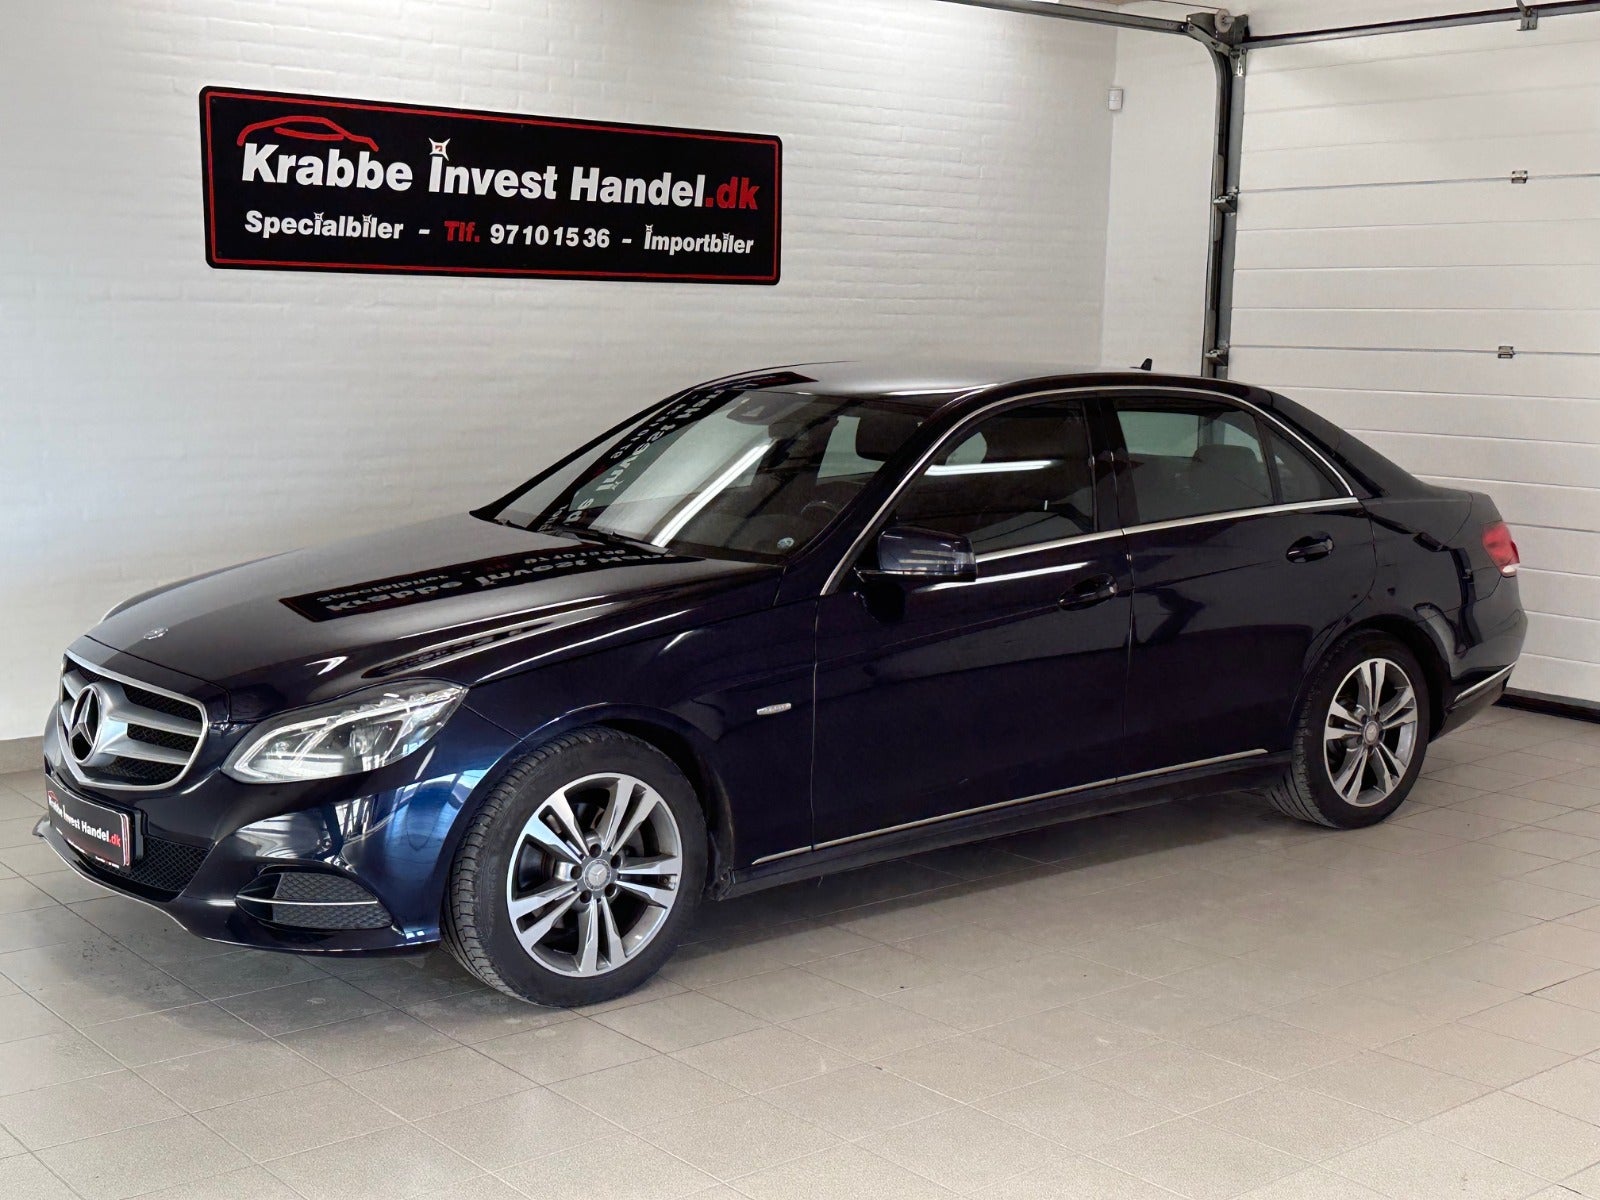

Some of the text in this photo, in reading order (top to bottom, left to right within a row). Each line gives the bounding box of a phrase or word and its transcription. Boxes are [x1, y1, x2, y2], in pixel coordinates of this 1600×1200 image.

[241, 140, 760, 210] Krabbe Invest Handel.dk
[244, 210, 404, 239] Specialbiler
[444, 220, 481, 242] Tlf.
[643, 225, 754, 256] Importbiler
[81, 820, 121, 848] Handel.dk
